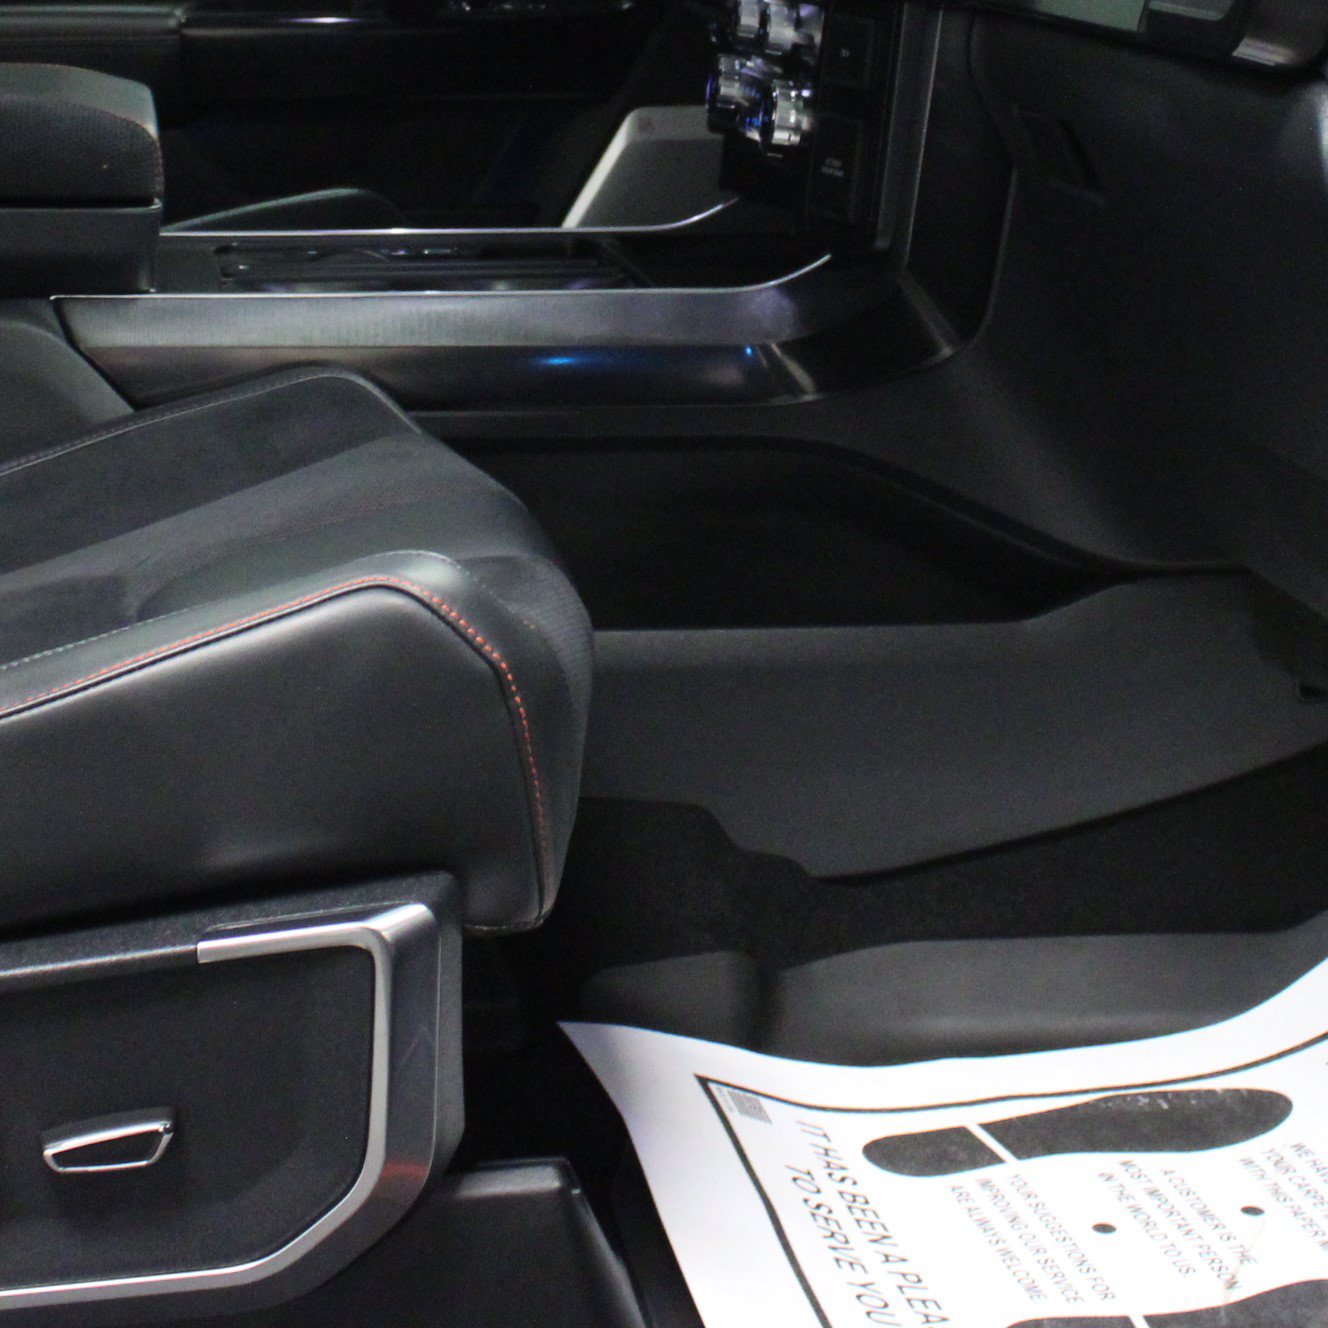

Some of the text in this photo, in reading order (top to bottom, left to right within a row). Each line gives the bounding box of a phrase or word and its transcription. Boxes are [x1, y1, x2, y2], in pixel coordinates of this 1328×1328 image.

[1262, 1147, 1297, 1175] YOUR
[1290, 1142, 1315, 1159] WE
[796, 1120, 950, 1328] IT HAS BEEN A PLEA
[1169, 1176, 1226, 1230] CUSTOMER
[1285, 1203, 1326, 1238] PAPER
[785, 1164, 903, 1327] TO SERVE YOU
[949, 1185, 1048, 1304] ARE ALWAYS WELCOME
[976, 1178, 1085, 1304] IMPROVING OUR SERVICE
[1008, 1173, 1116, 1301] YOUR SUGGESTIONS FOR
[1125, 1204, 1168, 1240] WORLD
[1159, 1243, 1182, 1257] TO
[1193, 1243, 1241, 1290] PERSON
